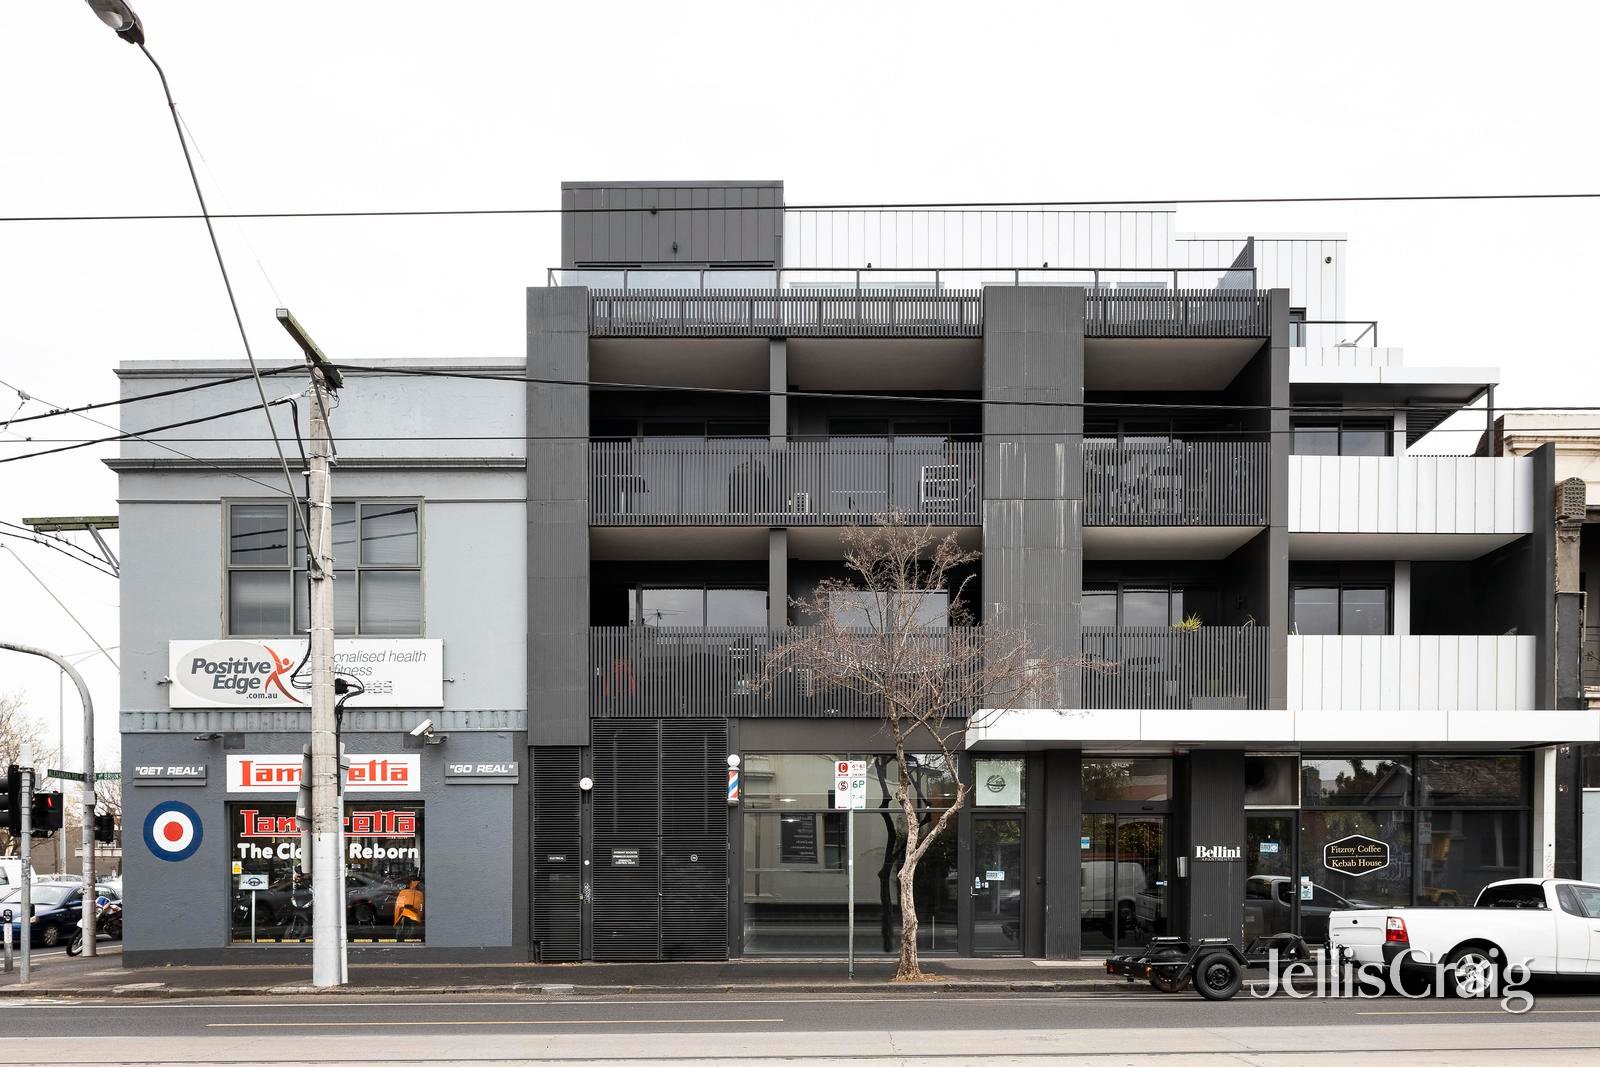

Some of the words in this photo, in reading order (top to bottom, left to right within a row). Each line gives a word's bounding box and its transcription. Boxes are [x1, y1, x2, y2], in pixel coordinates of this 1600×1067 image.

[334, 650, 387, 663] onalised
[388, 650, 427, 663] health
[191, 657, 271, 675] Positive
[334, 664, 373, 677] fitness
[213, 675, 261, 695] Edge
[246, 692, 278, 700] .com.au
[135, 766, 164, 776] "GET
[166, 766, 204, 776] REAL"
[239, 760, 408, 787] Lametta
[449, 764, 473, 773] "GO
[476, 764, 514, 773] REAL"
[852, 780, 865, 788] 6P
[240, 809, 415, 837] Lametta
[237, 842, 273, 860] The
[349, 842, 419, 860] Reborn
[1195, 845, 1241, 858] Bellini
[1331, 845, 1356, 854] Fitzroy
[1357, 844, 1382, 853] Coffee
[1332, 859, 1357, 868] Kebab
[1358, 858, 1383, 867] House
